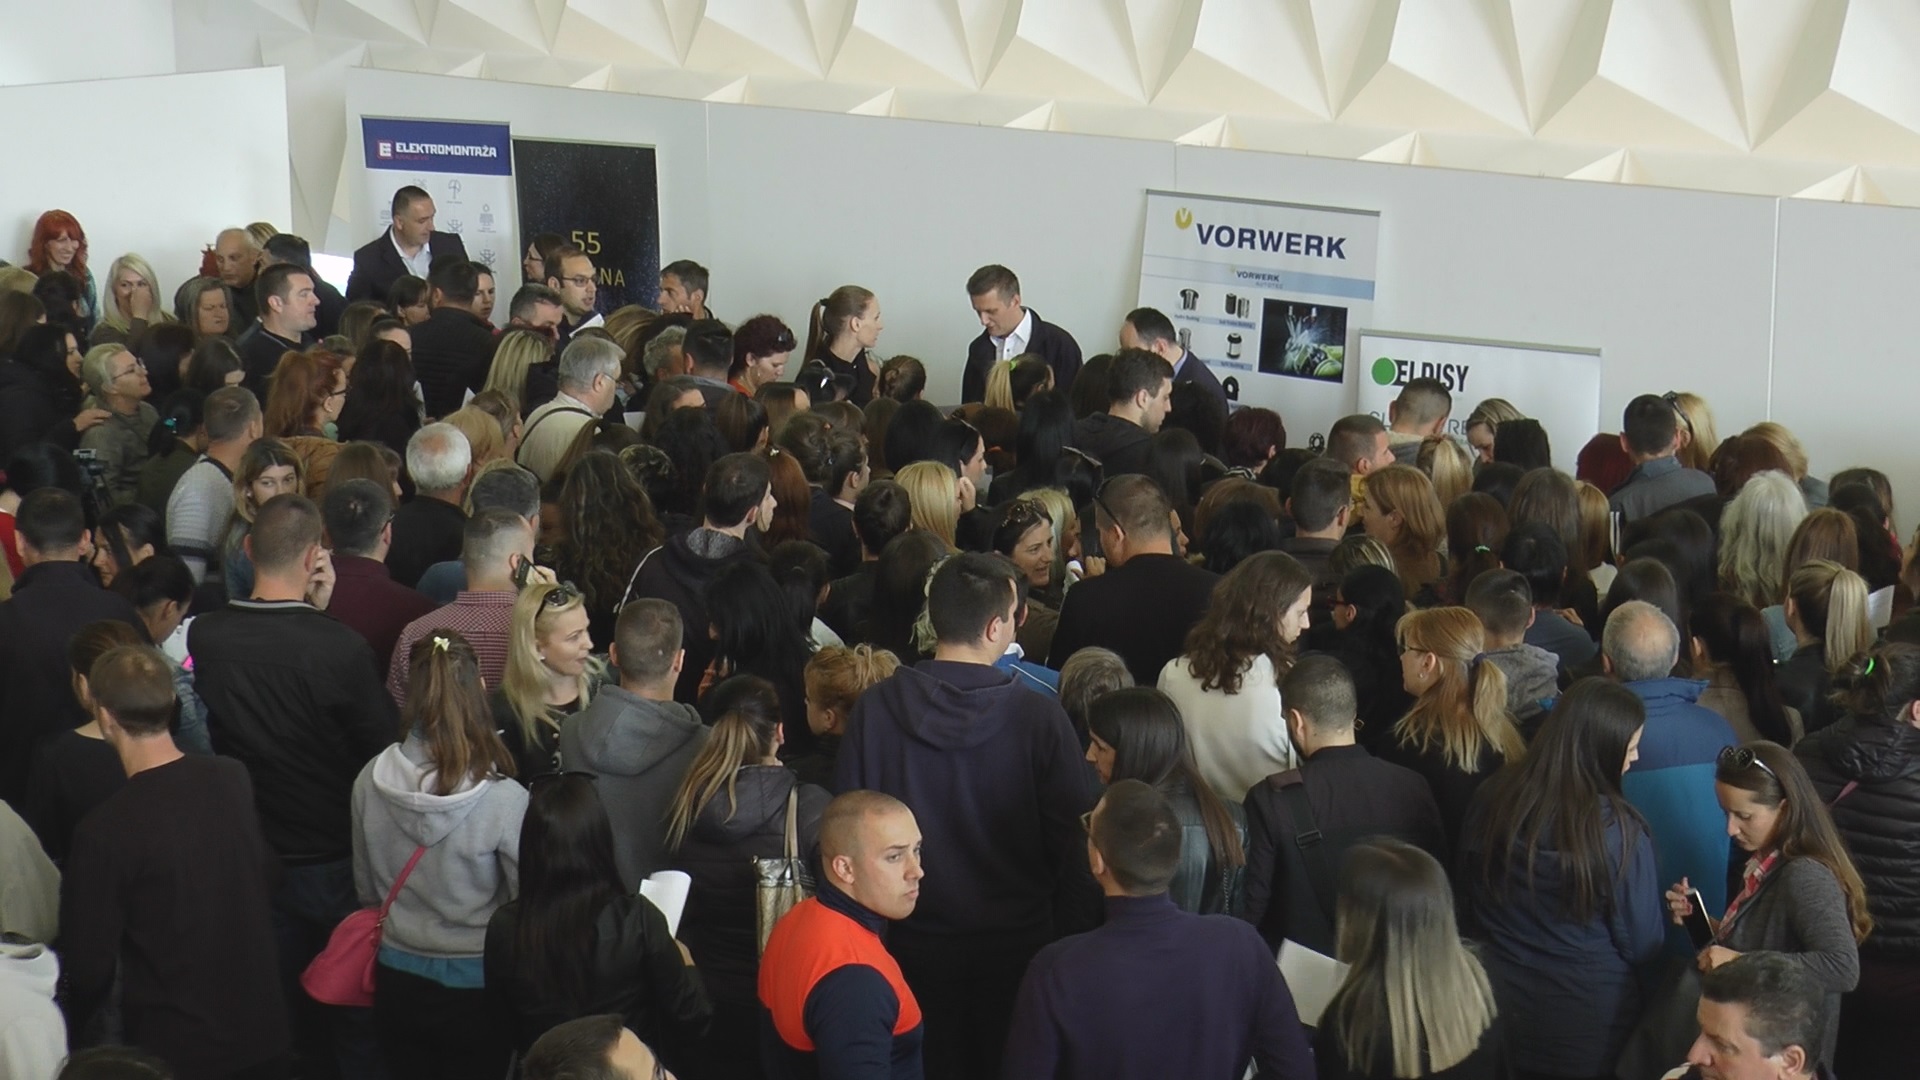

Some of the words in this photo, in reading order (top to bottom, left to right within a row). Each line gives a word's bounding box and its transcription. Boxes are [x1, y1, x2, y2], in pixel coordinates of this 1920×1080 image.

[395, 141, 497, 158] ELEKTROMONTAŽA
[571, 230, 601, 255] 55
[1196, 223, 1347, 260] VORWERK
[1236, 270, 1280, 282] VORWERK
